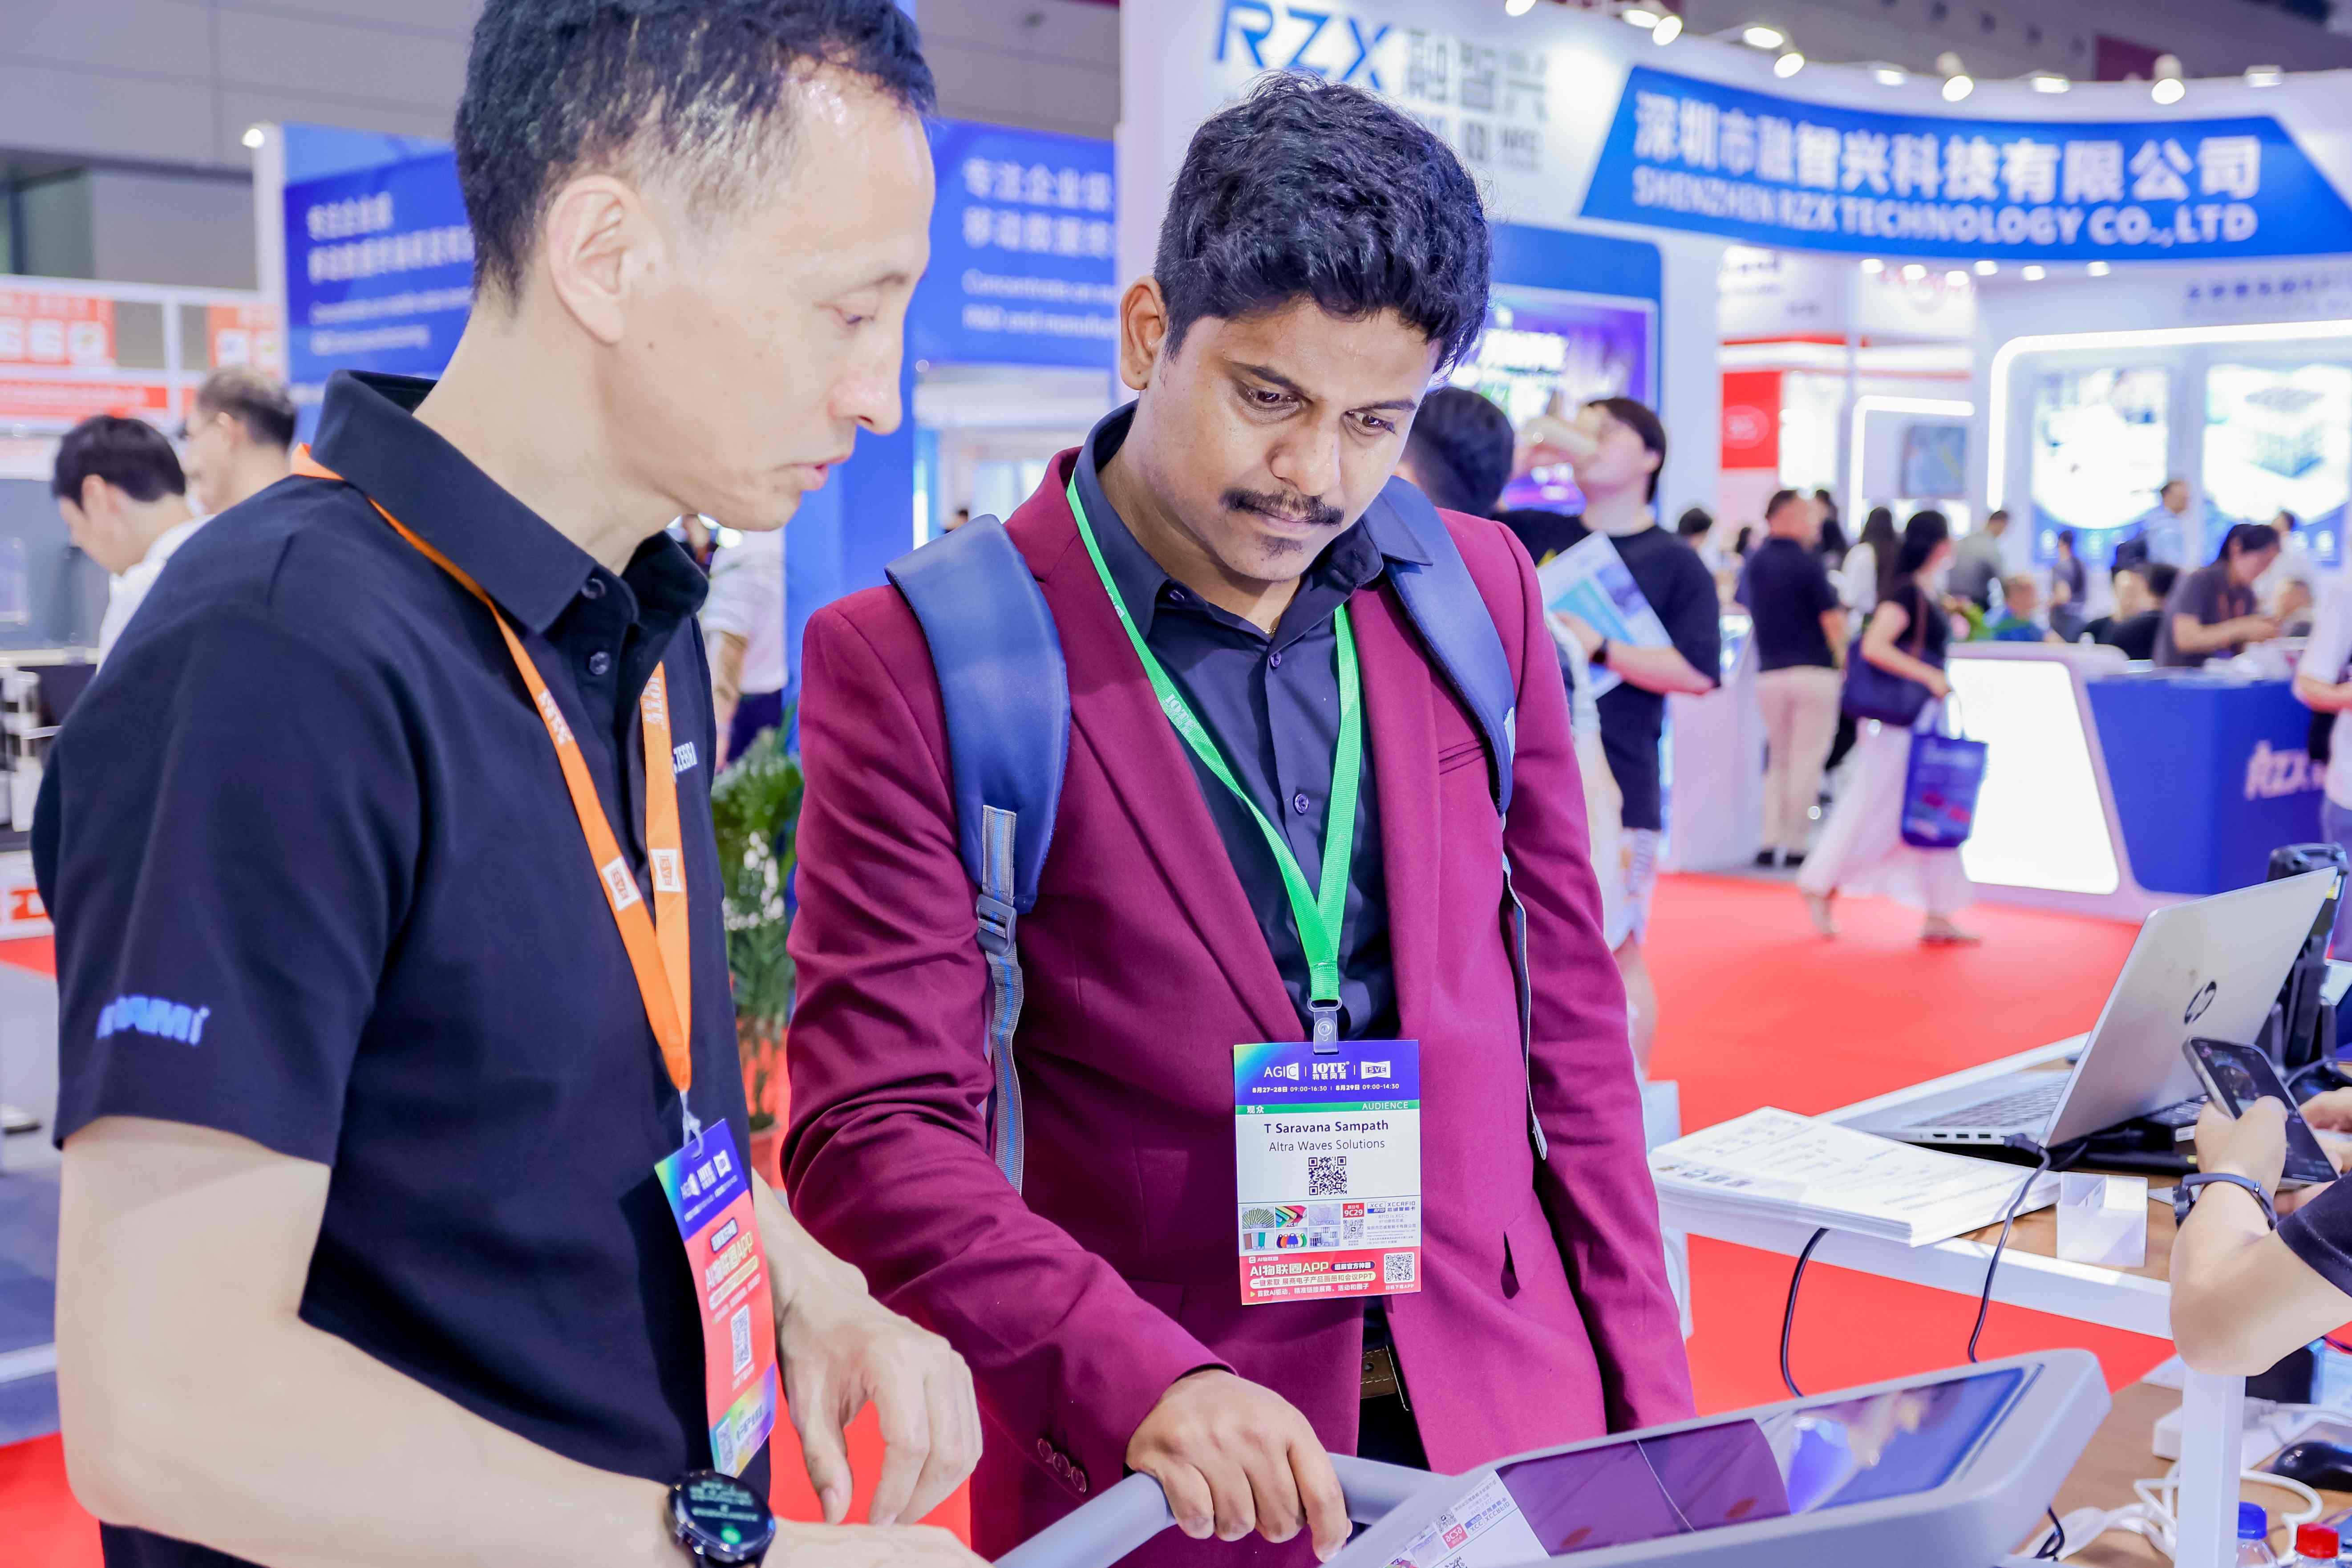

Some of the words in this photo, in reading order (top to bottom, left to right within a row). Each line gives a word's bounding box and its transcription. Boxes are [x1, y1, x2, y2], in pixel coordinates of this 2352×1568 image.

[1214, 0, 1392, 91] RZX
[1841, 196, 2085, 246] TECHNOLOGY
[1264, 1062, 1299, 1081] AGIC
[1247, 1105, 1264, 1114] 观众
[1362, 1101, 1409, 1110] AUDIENCE
[1264, 1123, 1271, 1134] T
[1275, 1122, 1331, 1134] Saravana
[1335, 1120, 1389, 1135] Sampath
[1269, 1141, 1294, 1152] Altra
[1298, 1140, 1332, 1151] Waves
[1336, 1139, 1385, 1150] Solutions
[1344, 1209, 1364, 1217] 9C29
[1249, 1261, 1329, 1277] AI物联圈APP
[1253, 1278, 1280, 1287] 一键索取
[1282, 1273, 1373, 1285] 展商电子产品画册和会议PPT
